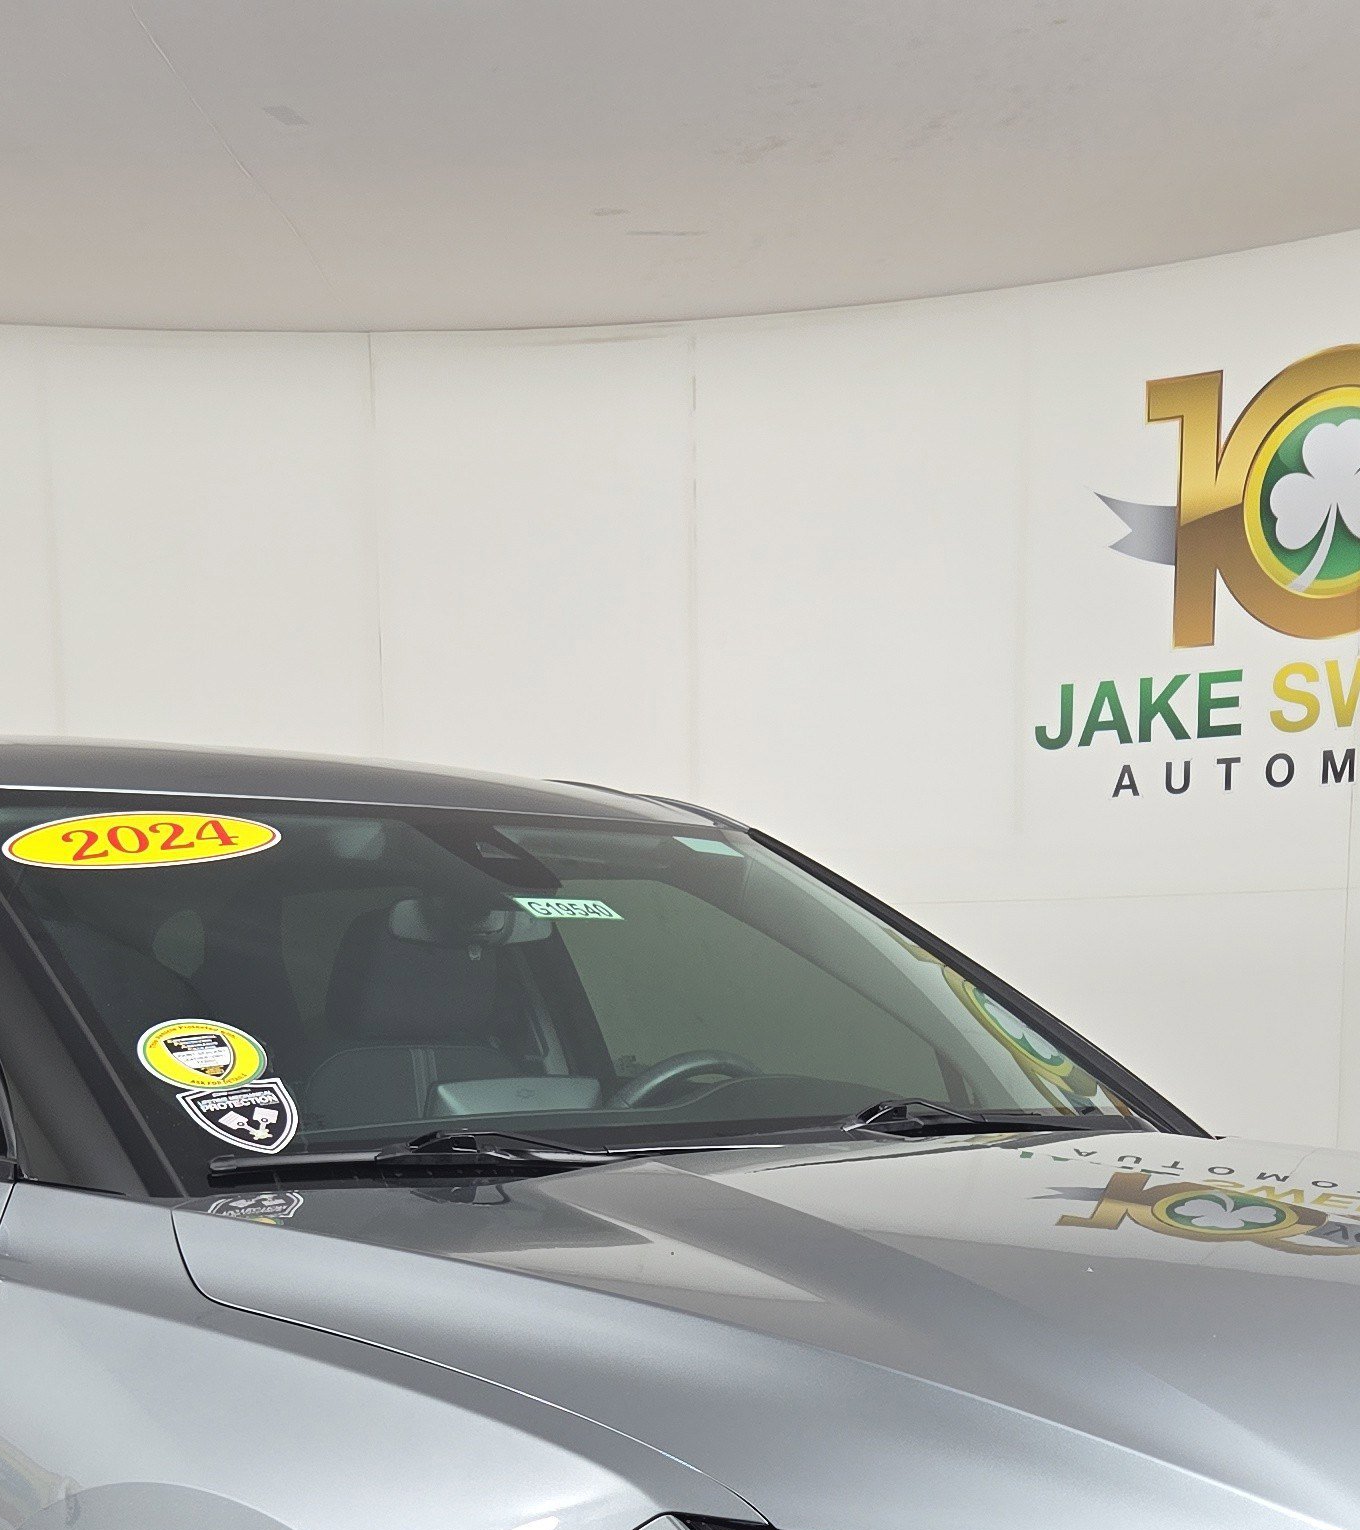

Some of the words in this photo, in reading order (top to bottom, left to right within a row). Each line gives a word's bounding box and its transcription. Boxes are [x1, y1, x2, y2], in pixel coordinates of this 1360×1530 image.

[1035, 669, 1243, 749] JAKE
[61, 820, 239, 861] 2024
[527, 901, 614, 918] G19540
[198, 1094, 280, 1113] PROTECTION
